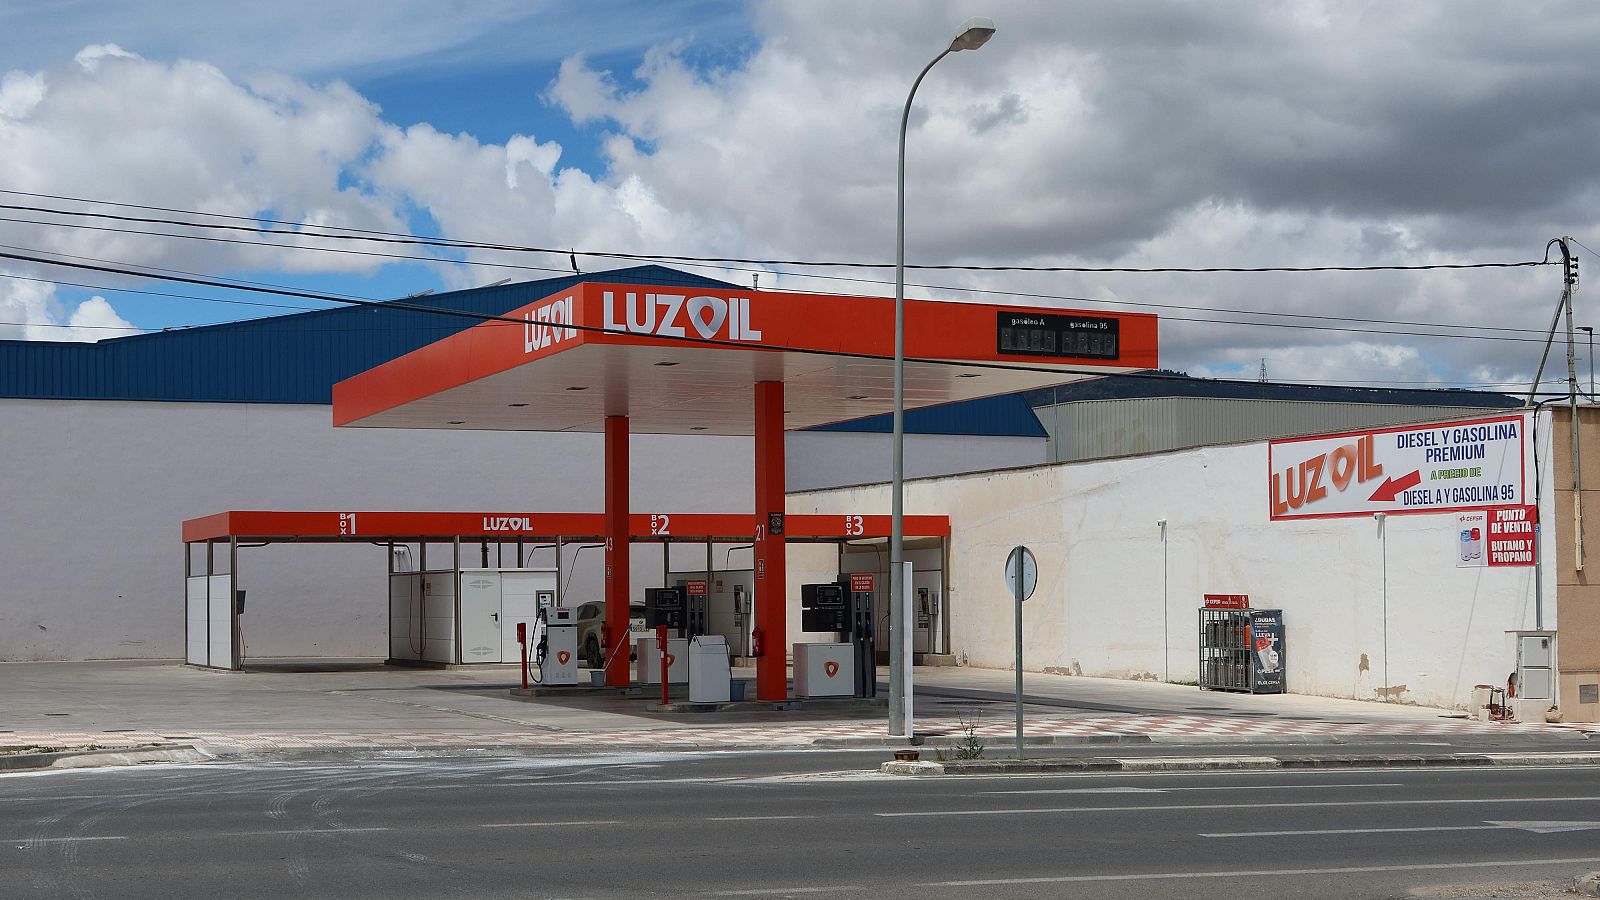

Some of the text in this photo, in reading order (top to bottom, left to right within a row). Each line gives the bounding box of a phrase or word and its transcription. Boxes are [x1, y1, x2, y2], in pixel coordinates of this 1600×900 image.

[524, 295, 577, 353] LUZOIL
[603, 291, 761, 341] LUZOIL
[1069, 321, 1097, 329] gasolina
[1397, 423, 1517, 449] DIESEL Y GASOLINA
[1426, 443, 1485, 463] PREMIUM
[1272, 435, 1383, 515] LUZOIL
[1430, 467, 1482, 480] A PRECIO DE
[1403, 484, 1514, 506] DIESEL A Y GASOLINA 95
[339, 513, 356, 535] BOX 1
[483, 517, 533, 531] LUZOIL
[657, 514, 670, 535] 2
[1496, 509, 1526, 521] PUNTO
[755, 524, 765, 542] 21
[852, 515, 864, 536] 3
[1491, 521, 1532, 534] DE VENTA
[1491, 540, 1532, 552] BUTANO Y
[1492, 551, 1532, 562] PROPANO
